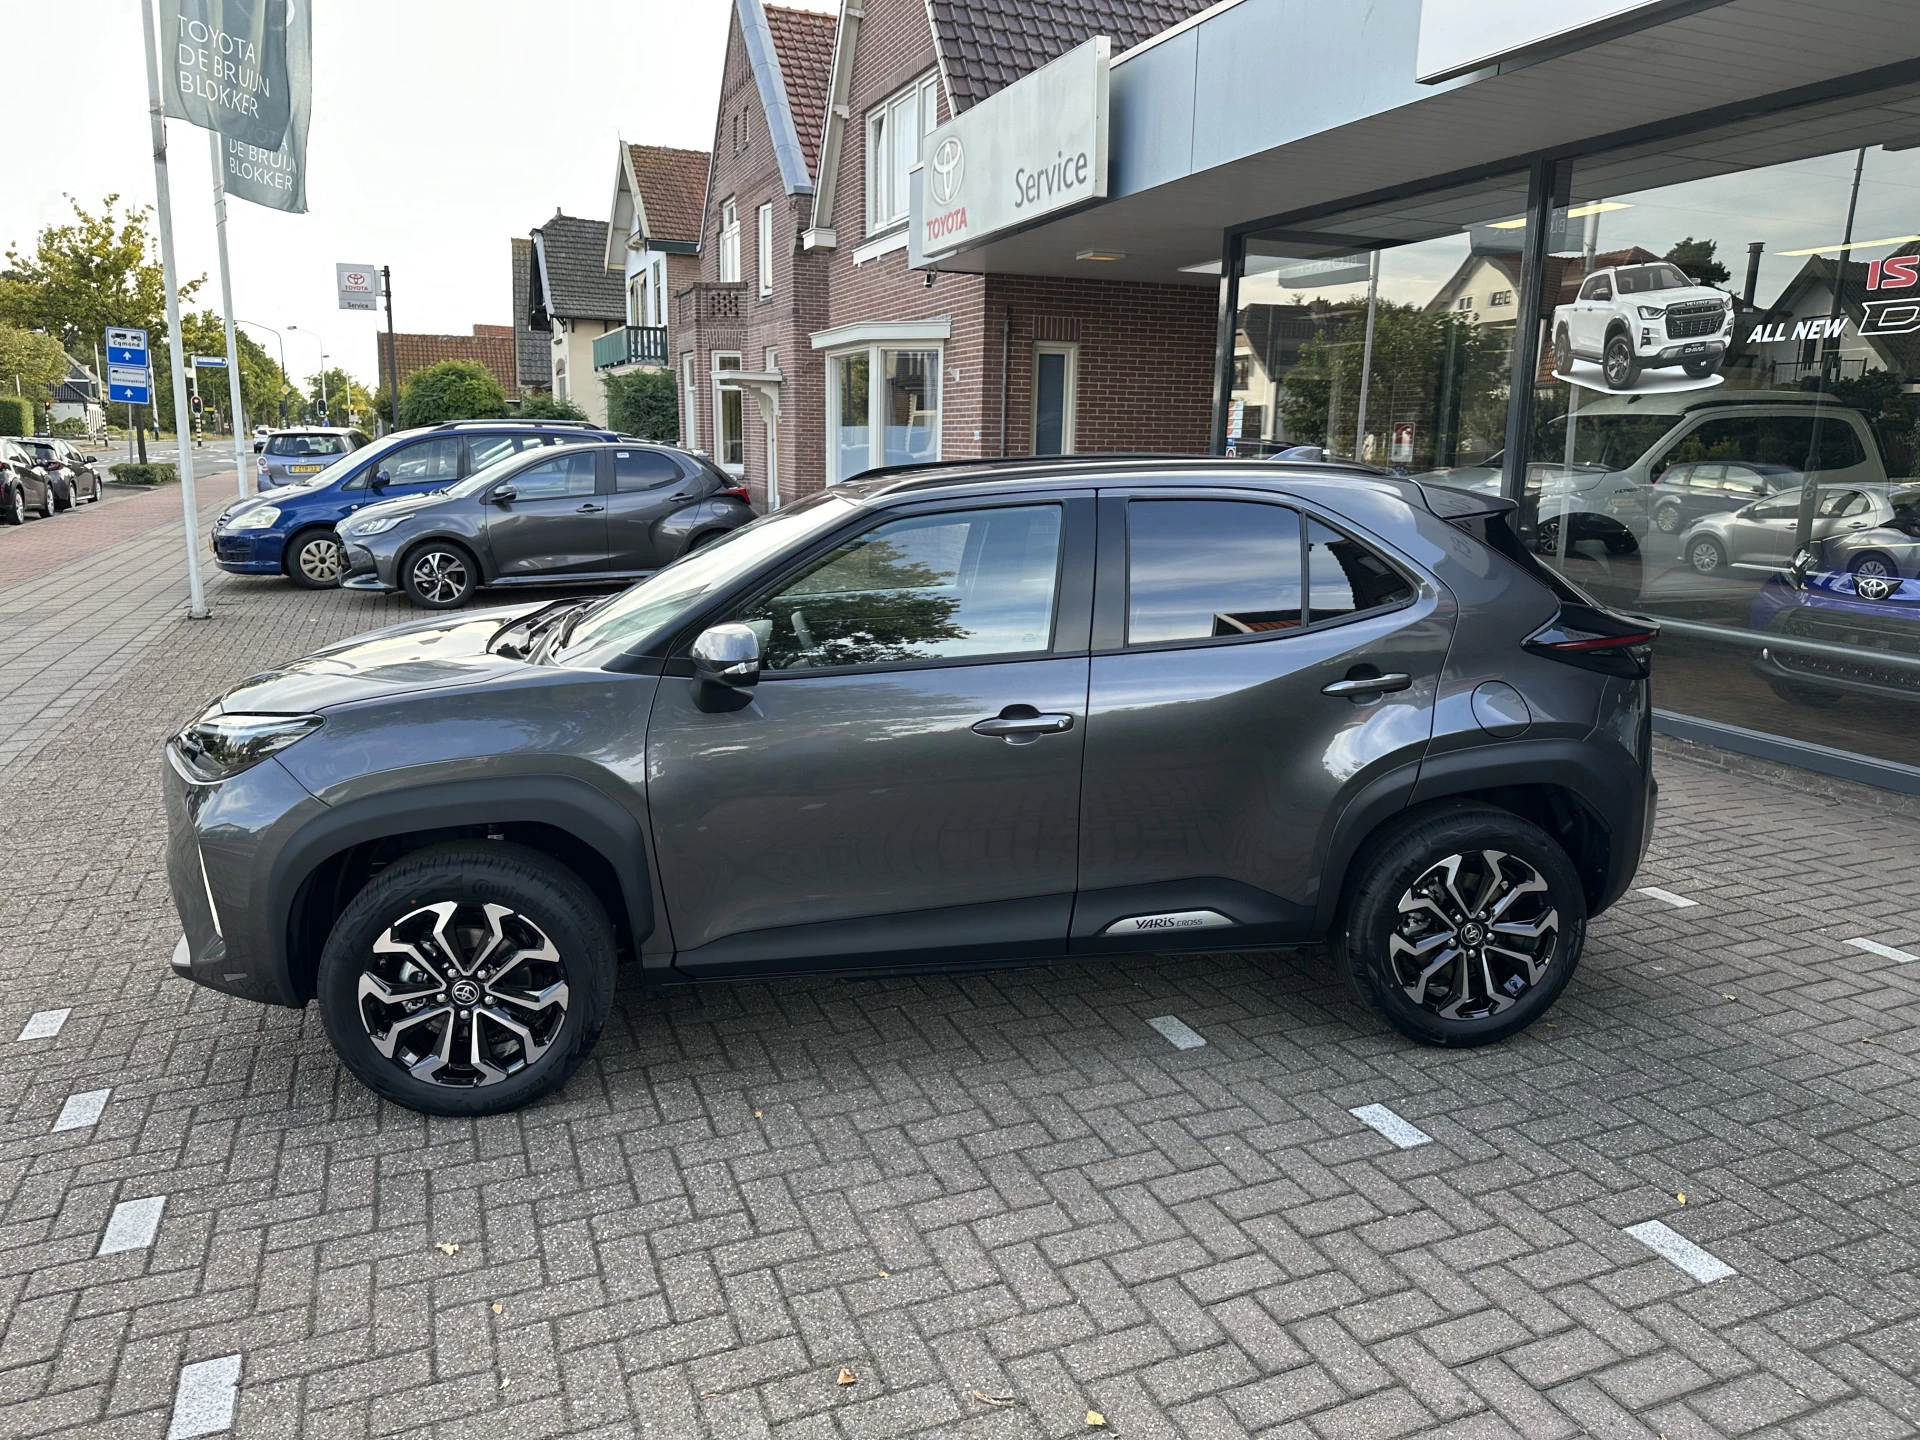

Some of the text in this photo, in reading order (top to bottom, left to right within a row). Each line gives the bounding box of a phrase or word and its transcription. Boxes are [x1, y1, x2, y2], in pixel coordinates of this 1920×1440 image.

[177, 14, 256, 64] TOYOTA
[178, 43, 270, 98] DE BRUIJN
[180, 71, 260, 119] BLOKKER
[229, 138, 244, 157] DE
[229, 157, 293, 191] BLOKKER
[1014, 150, 1088, 208] Service
[926, 206, 968, 241] TOYOTA
[347, 301, 369, 309] Service
[113, 339, 141, 348] Egmond
[1746, 317, 1850, 344] ALL NEW
[1176, 918, 1203, 927] CROSS
